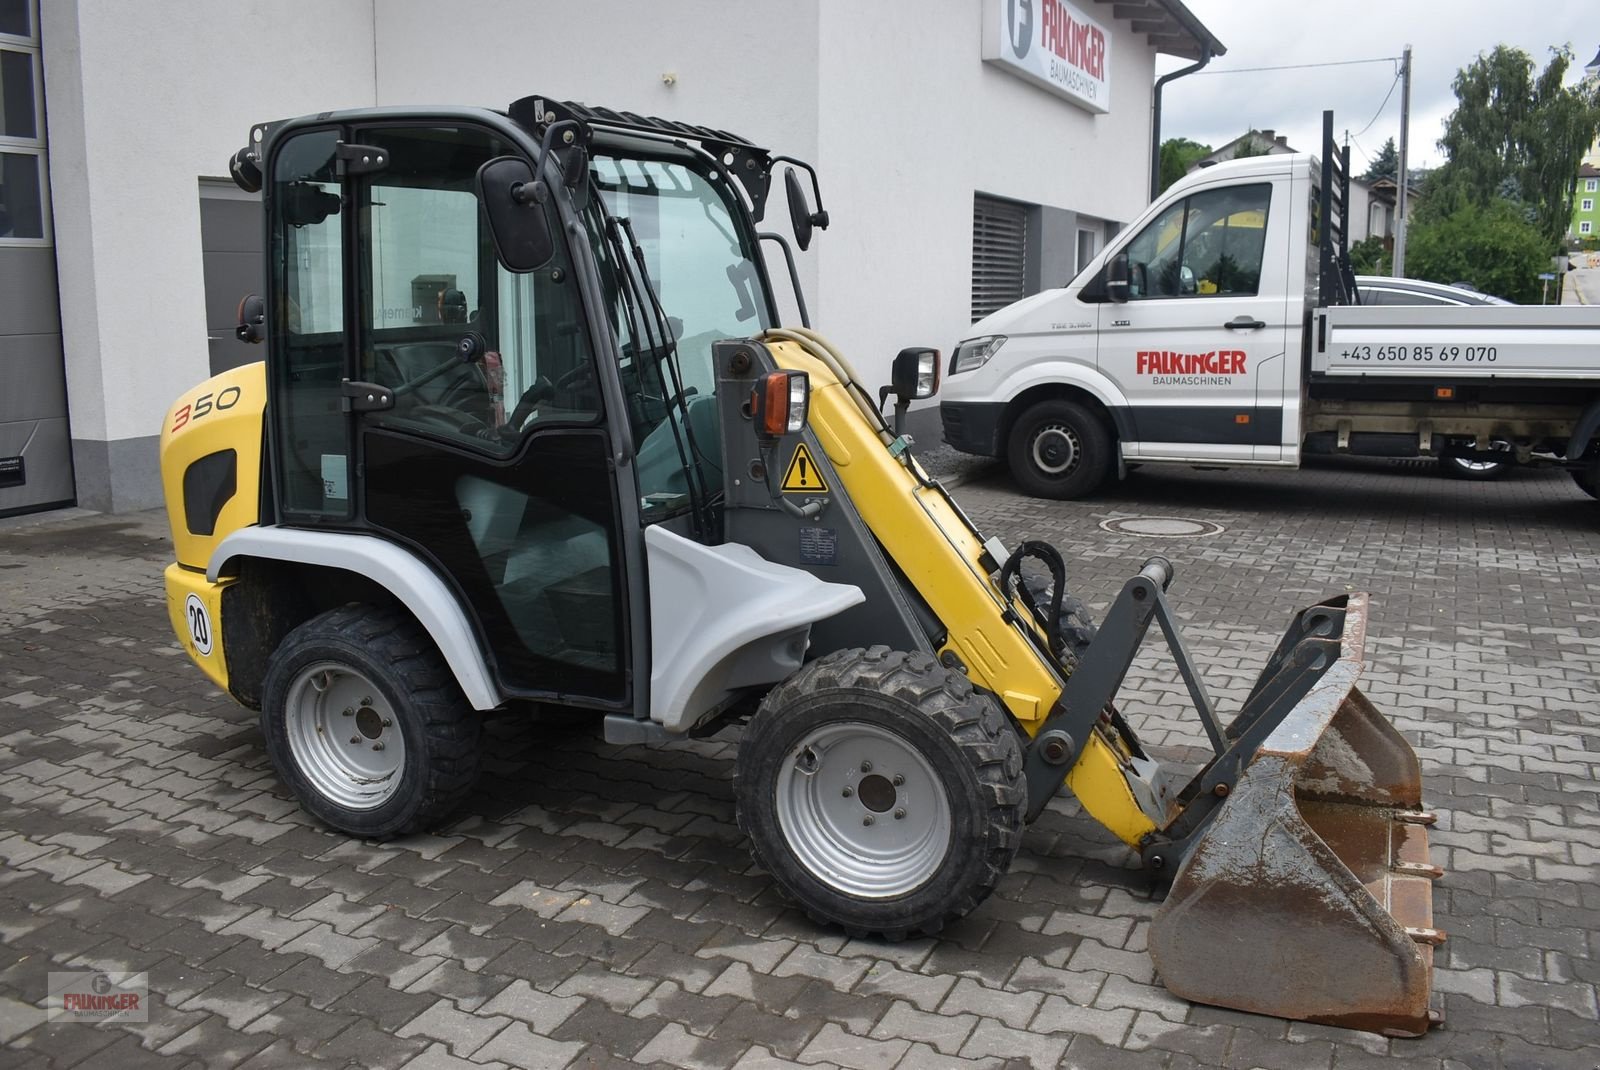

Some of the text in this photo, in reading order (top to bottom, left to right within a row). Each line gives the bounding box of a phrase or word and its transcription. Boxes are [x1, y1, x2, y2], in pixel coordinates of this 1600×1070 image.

[1041, 0, 1106, 83] FALKINGER
[1050, 59, 1098, 100] BAUMASCHINEN
[1136, 350, 1247, 375] FALKINGER
[1341, 346, 1497, 362] +43 650 85 69 070
[1152, 376, 1232, 386] BAUMASCHINEN
[171, 386, 241, 433] 350
[189, 604, 208, 645] 20
